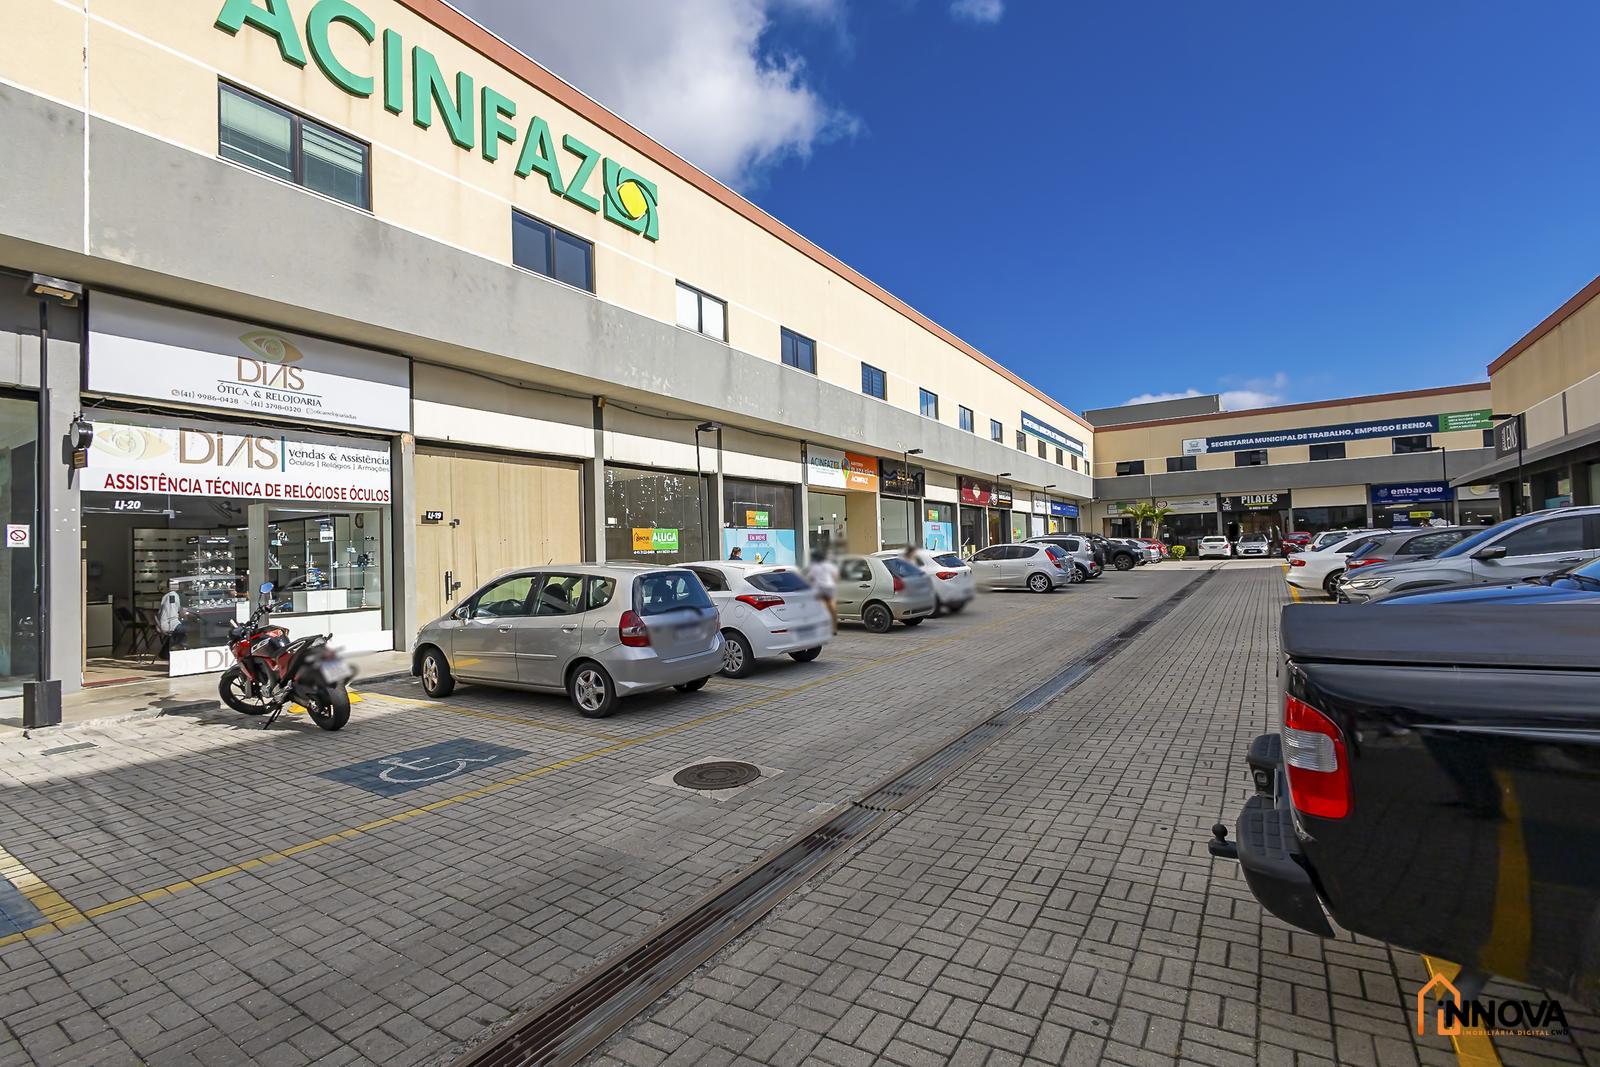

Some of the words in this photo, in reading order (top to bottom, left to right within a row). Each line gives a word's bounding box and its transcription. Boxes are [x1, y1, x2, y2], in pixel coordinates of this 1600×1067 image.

[214, 0, 600, 214] ACINFAZ
[180, 389, 195, 399] (41)
[250, 399, 263, 408] (41)
[217, 382, 249, 397] ÓTICA
[253, 390, 262, 399] &
[265, 391, 322, 408] RELOJOARIA
[1210, 439, 1254, 448] SECRETARIA
[1255, 435, 1297, 444] MUNICIPAL
[1308, 429, 1354, 439] TRABALHO,
[1354, 425, 1395, 434] EMPREGO
[1402, 421, 1432, 430] RENDA
[288, 449, 326, 460] Vendas
[328, 453, 337, 461] &
[340, 454, 390, 466] Assistência
[103, 472, 203, 494] ASSISTÊNCIA
[205, 477, 262, 496] TÉCNICA
[265, 483, 282, 497] DE
[349, 485, 389, 502] ÓCULOS
[1390, 486, 1443, 495] embarque
[1241, 494, 1278, 504] PILATES
[652, 532, 677, 542] ALUGA
